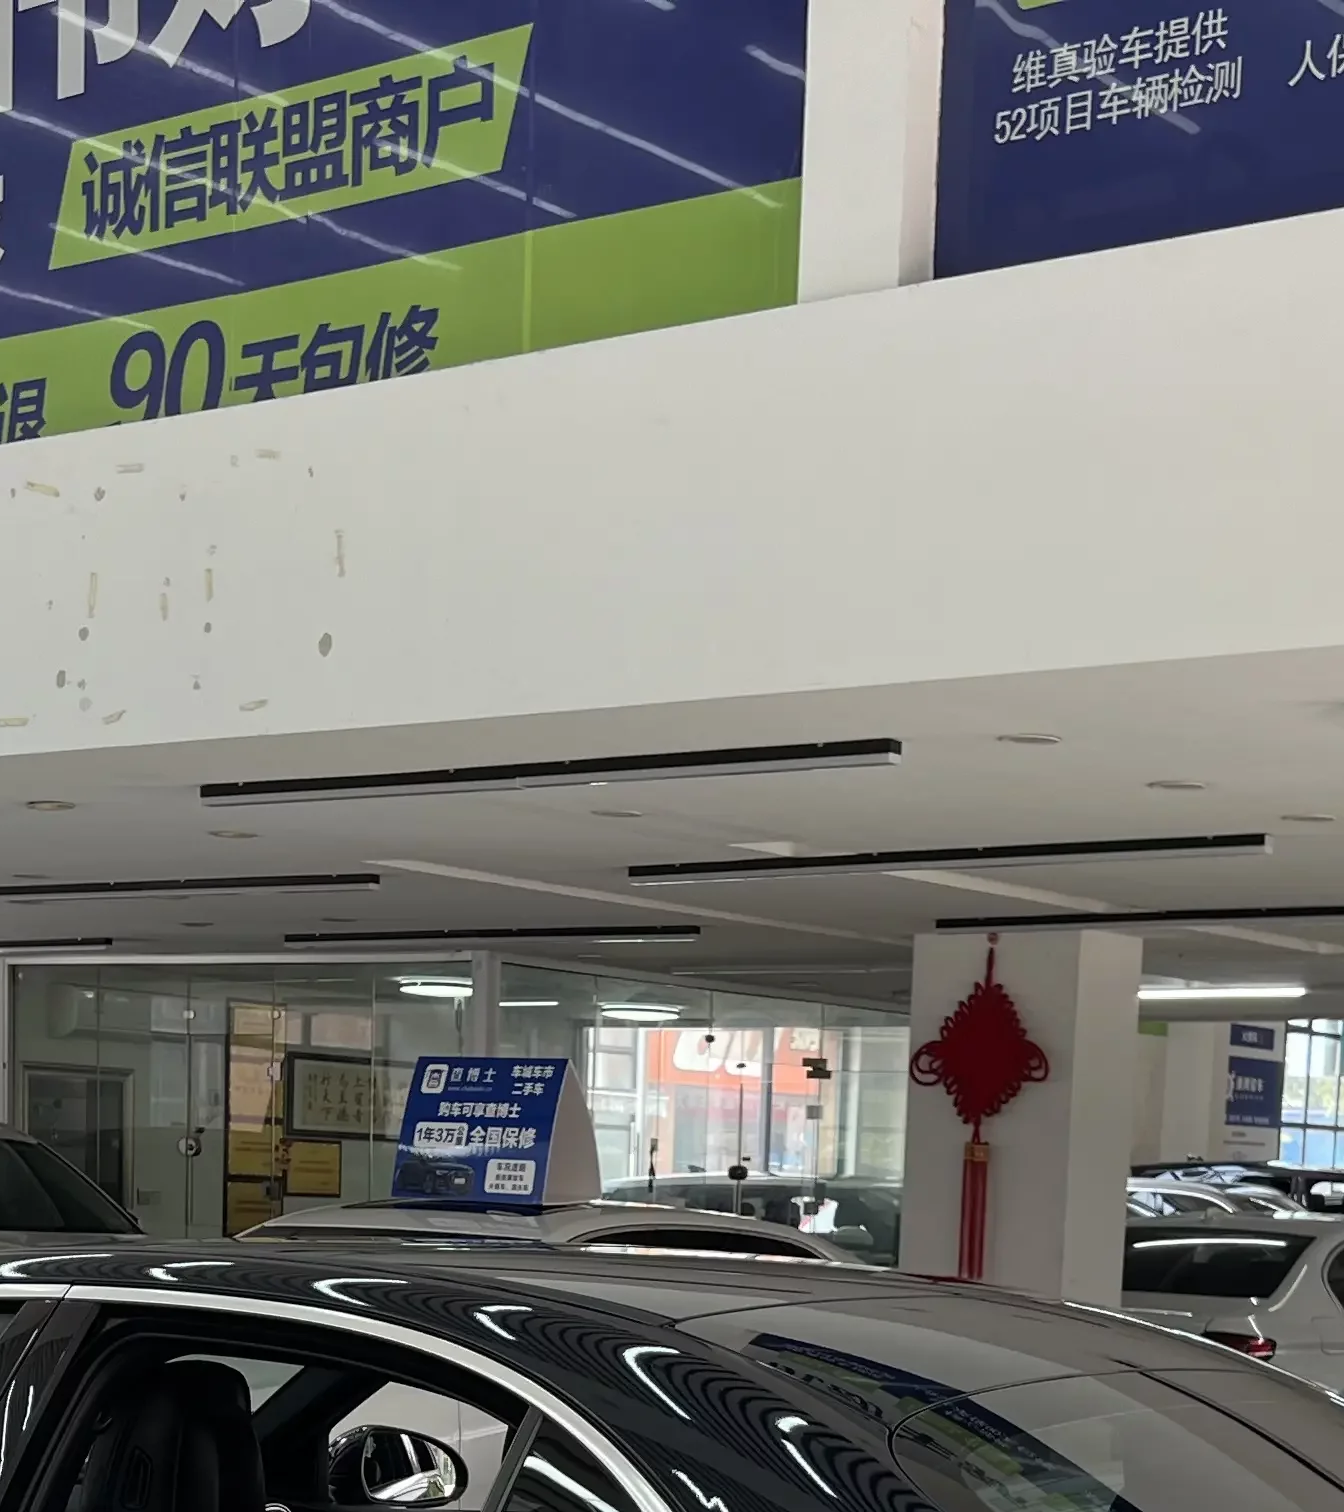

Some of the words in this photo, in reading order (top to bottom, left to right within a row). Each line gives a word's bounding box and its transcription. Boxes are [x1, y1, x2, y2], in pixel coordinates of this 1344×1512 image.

[1011, 9, 1229, 95] 维真验车提供
[993, 55, 1243, 145] 52项目车辆检测
[80, 56, 495, 242] 诚信联盟商户
[109, 304, 440, 427] 90天包修
[450, 1067, 497, 1083] 查博士
[511, 1082, 545, 1097] 二手车
[437, 1101, 522, 1119] 购车可享查博士
[469, 1125, 537, 1149] 全国保修
